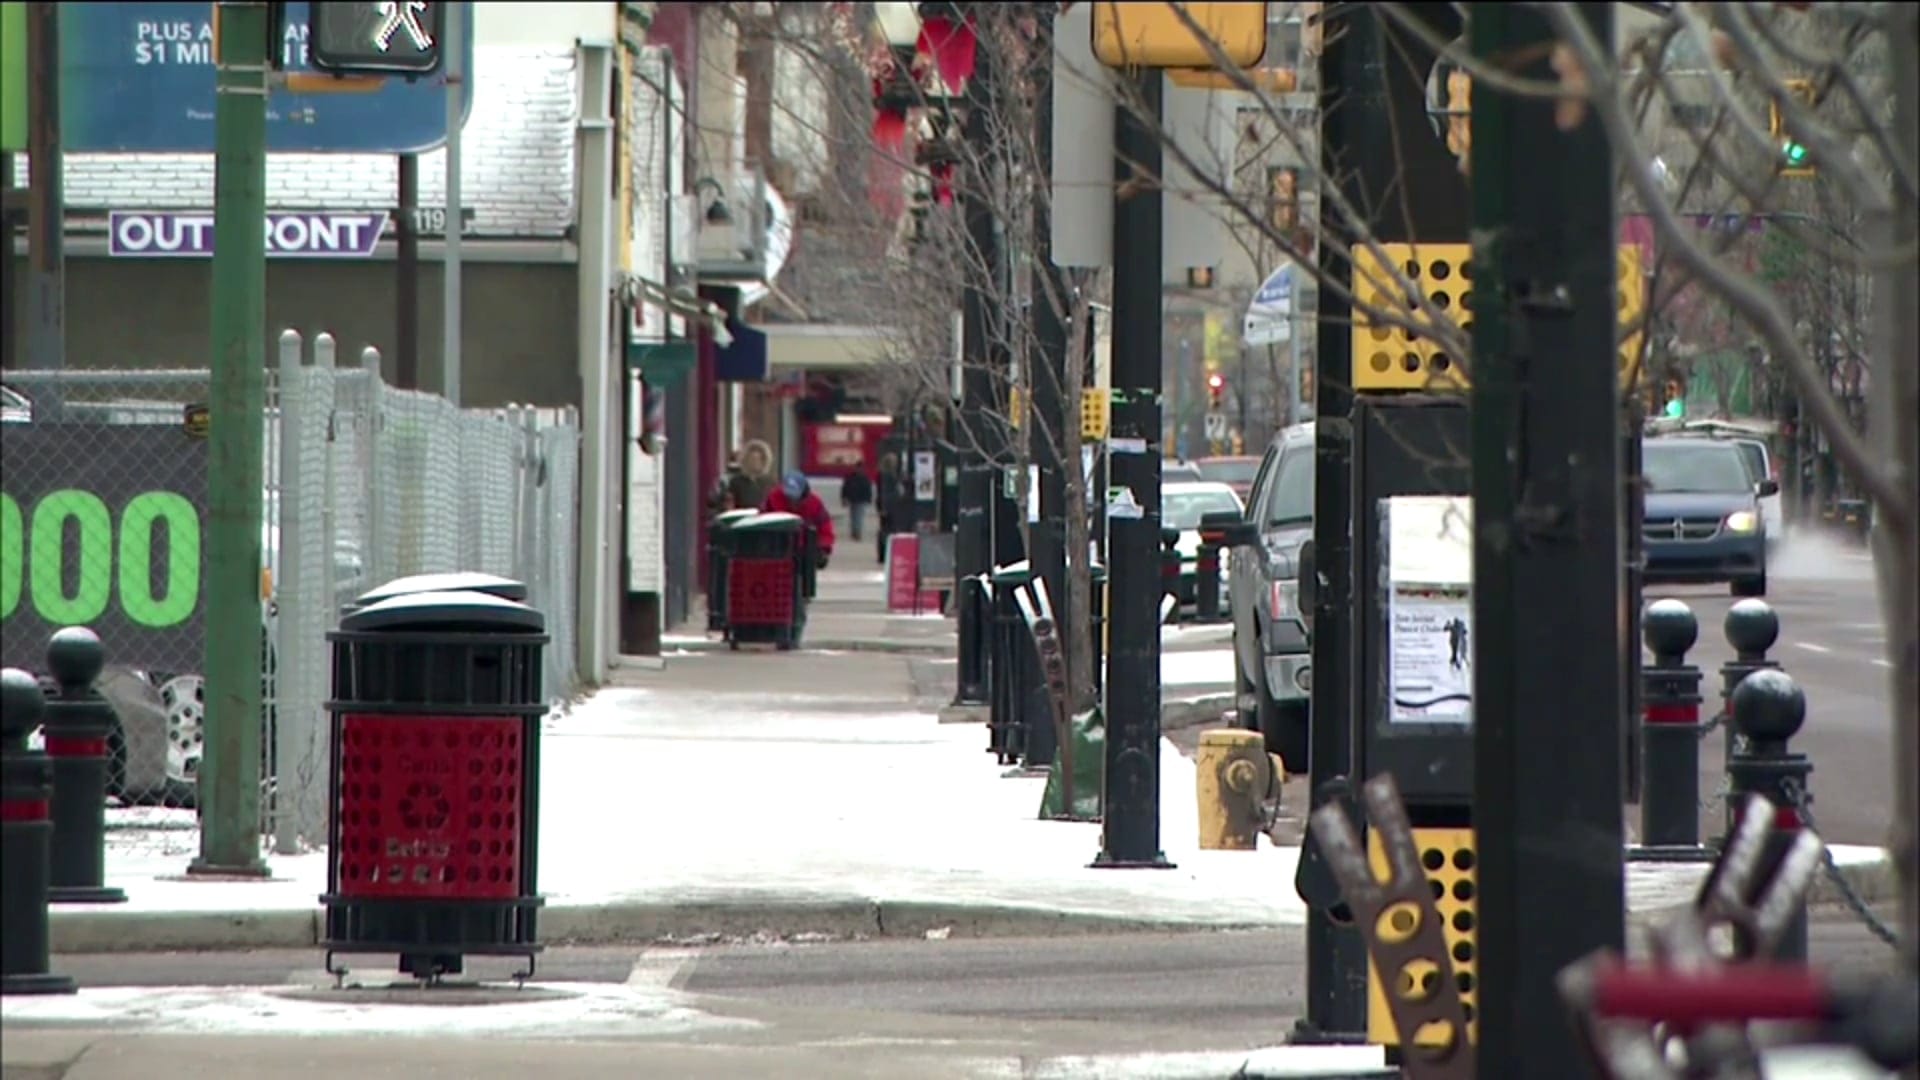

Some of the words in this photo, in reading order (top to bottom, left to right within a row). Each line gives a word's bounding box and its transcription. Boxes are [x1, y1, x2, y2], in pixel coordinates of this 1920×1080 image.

[138, 22, 192, 41] PLUS
[135, 41, 166, 65] $1
[119, 216, 372, 250] OUTONT
